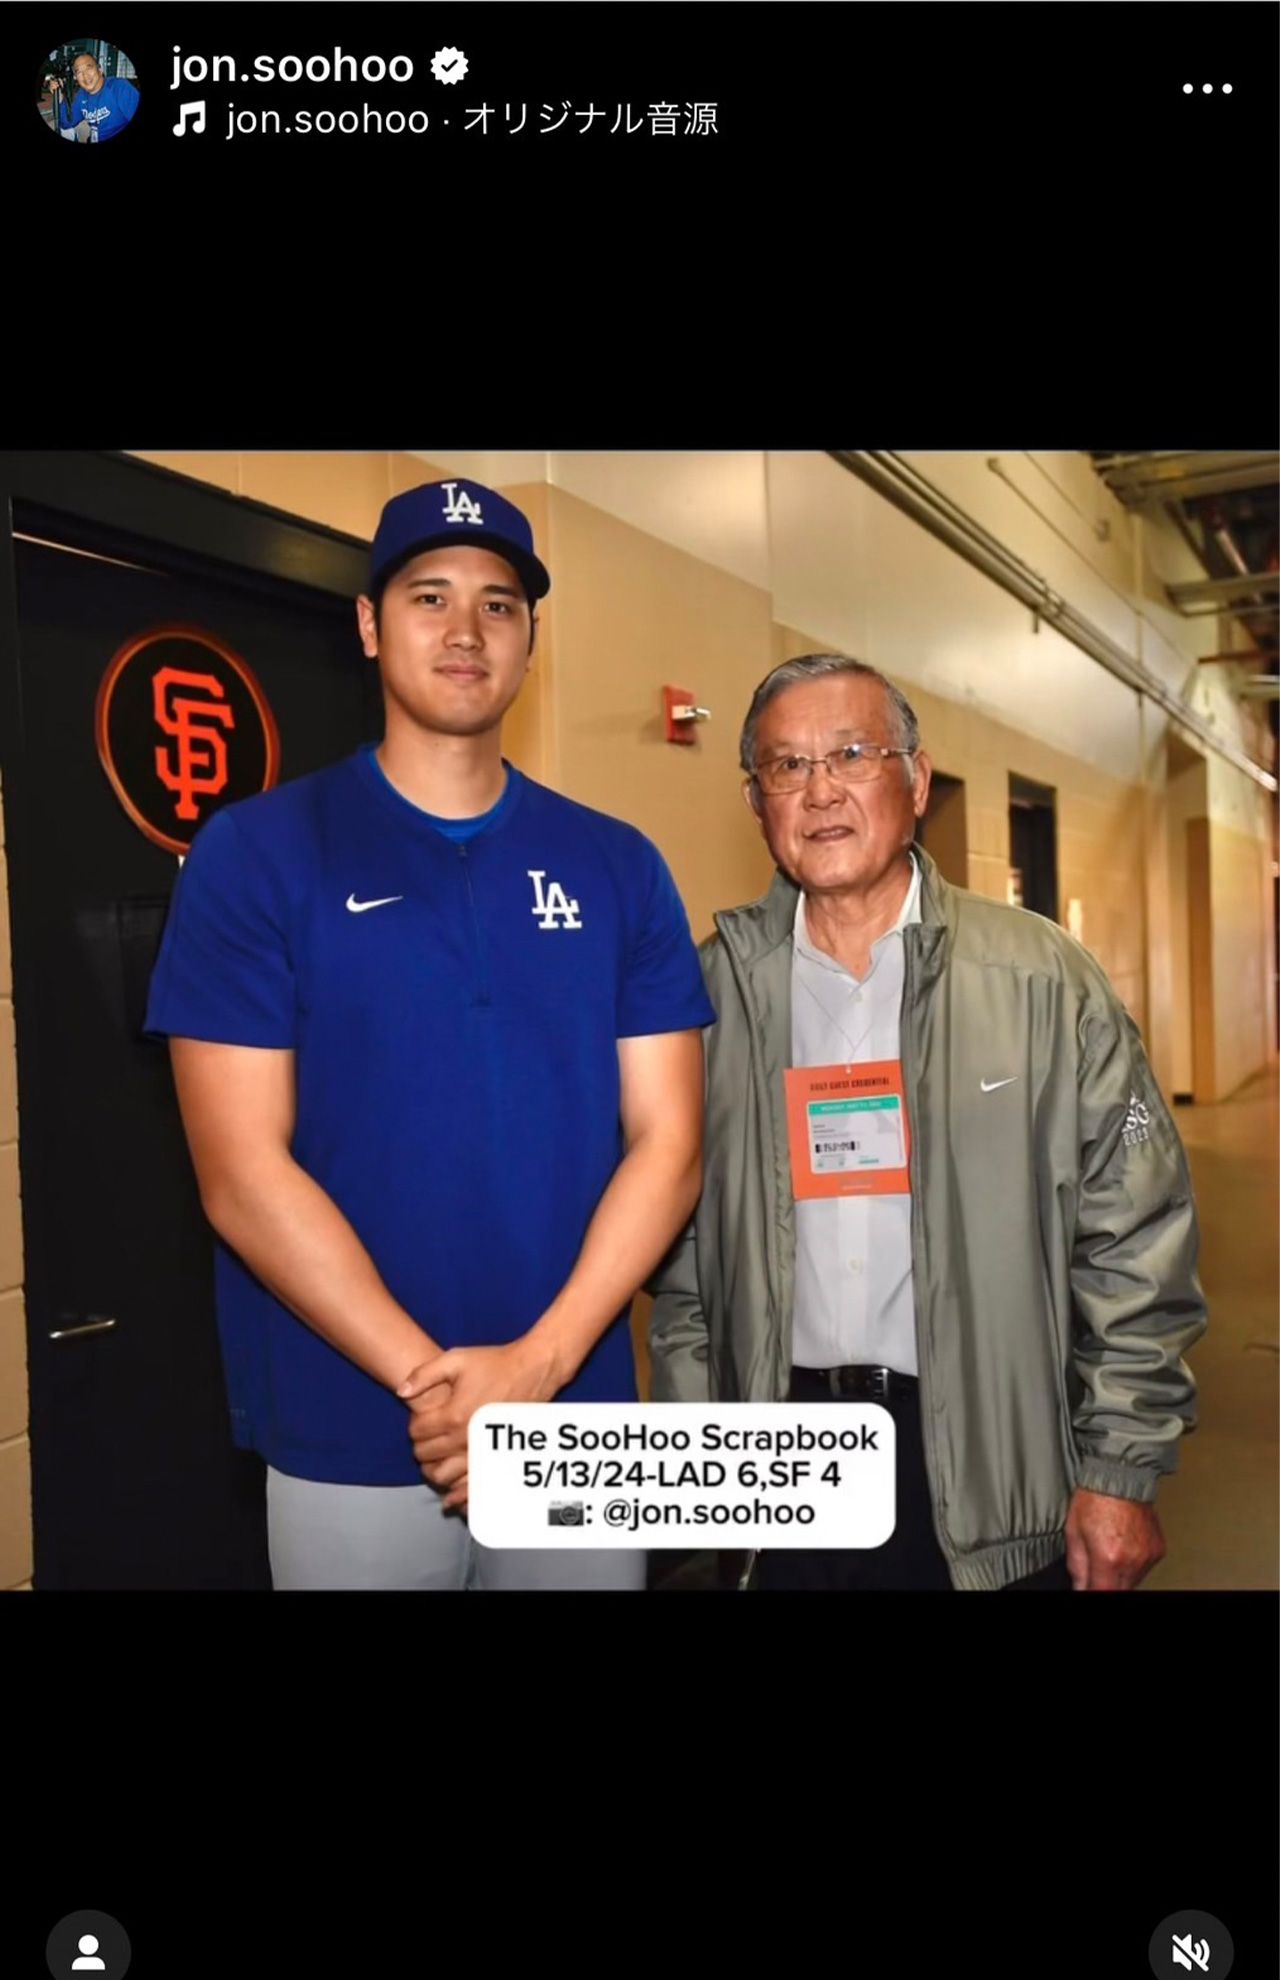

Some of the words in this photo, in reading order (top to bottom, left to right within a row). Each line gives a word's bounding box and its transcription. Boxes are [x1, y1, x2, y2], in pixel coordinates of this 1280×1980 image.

[441, 483, 484, 525] LA
[152, 666, 235, 820] SF
[527, 869, 583, 930] LA
